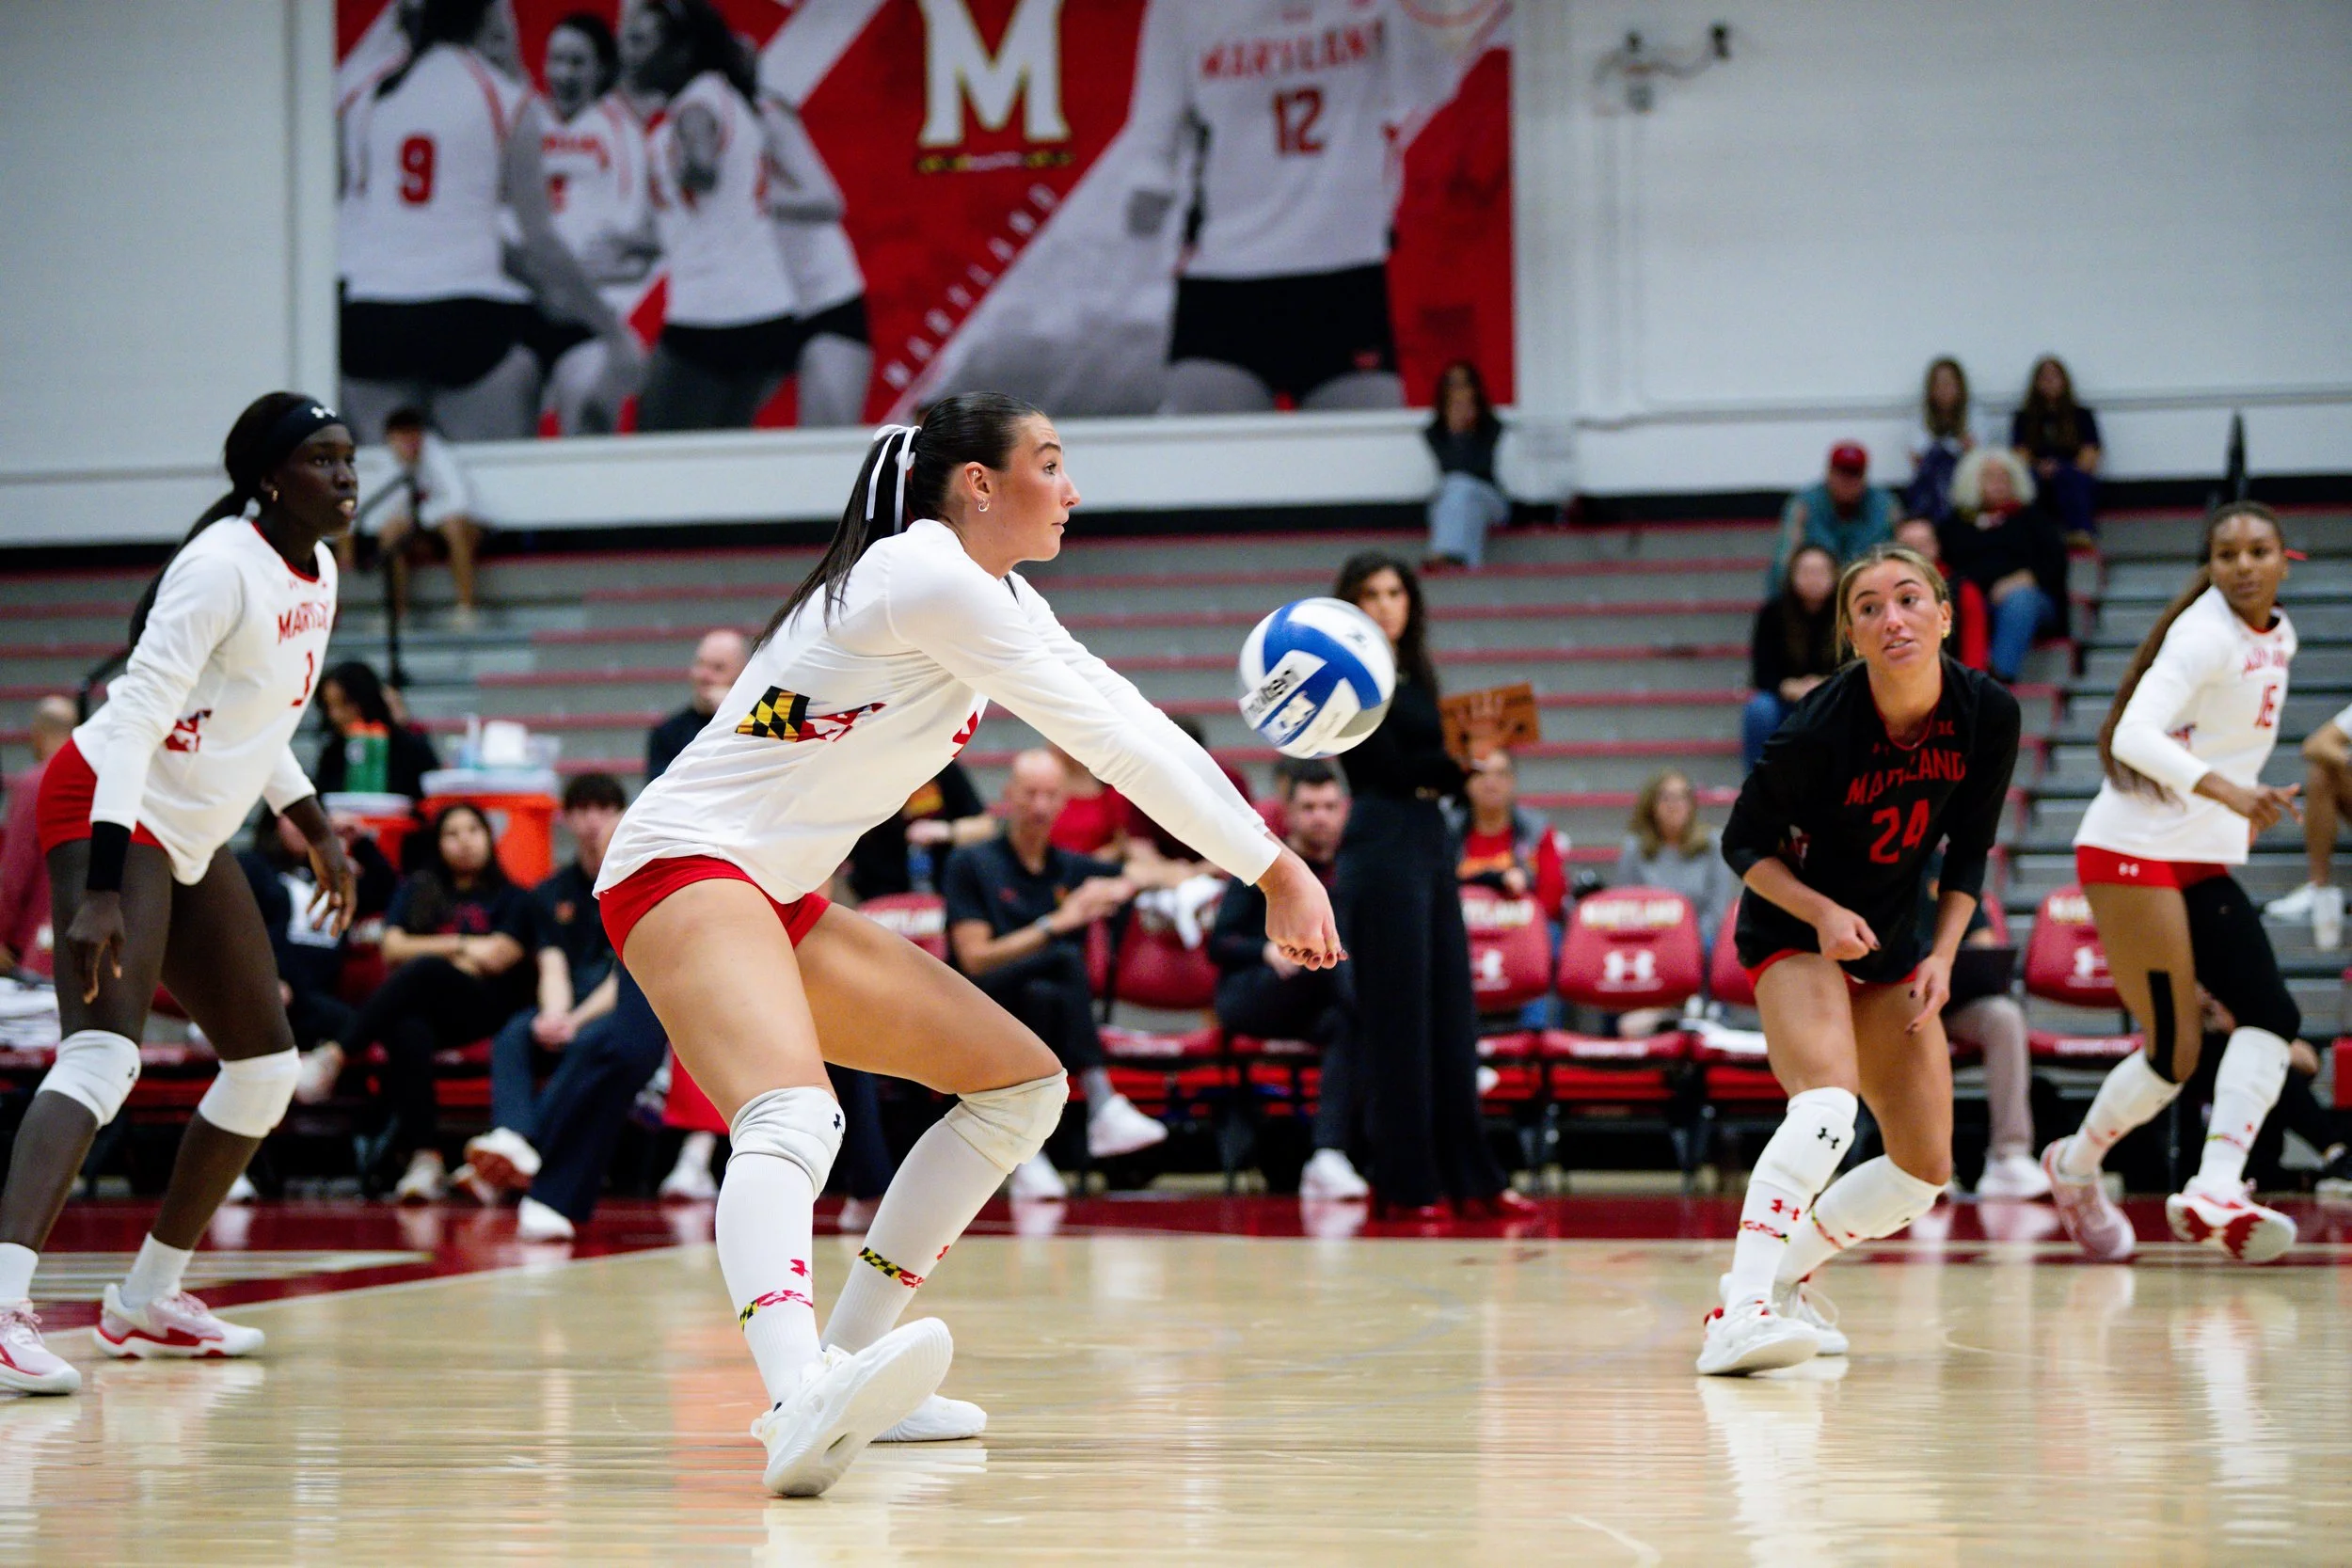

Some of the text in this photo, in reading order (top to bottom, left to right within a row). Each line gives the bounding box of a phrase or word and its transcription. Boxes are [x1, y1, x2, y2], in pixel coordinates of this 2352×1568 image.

[915, 0, 1072, 148] M
[1274, 87, 1326, 156] 12
[397, 132, 436, 208] 9
[1868, 799, 1930, 864] 24
